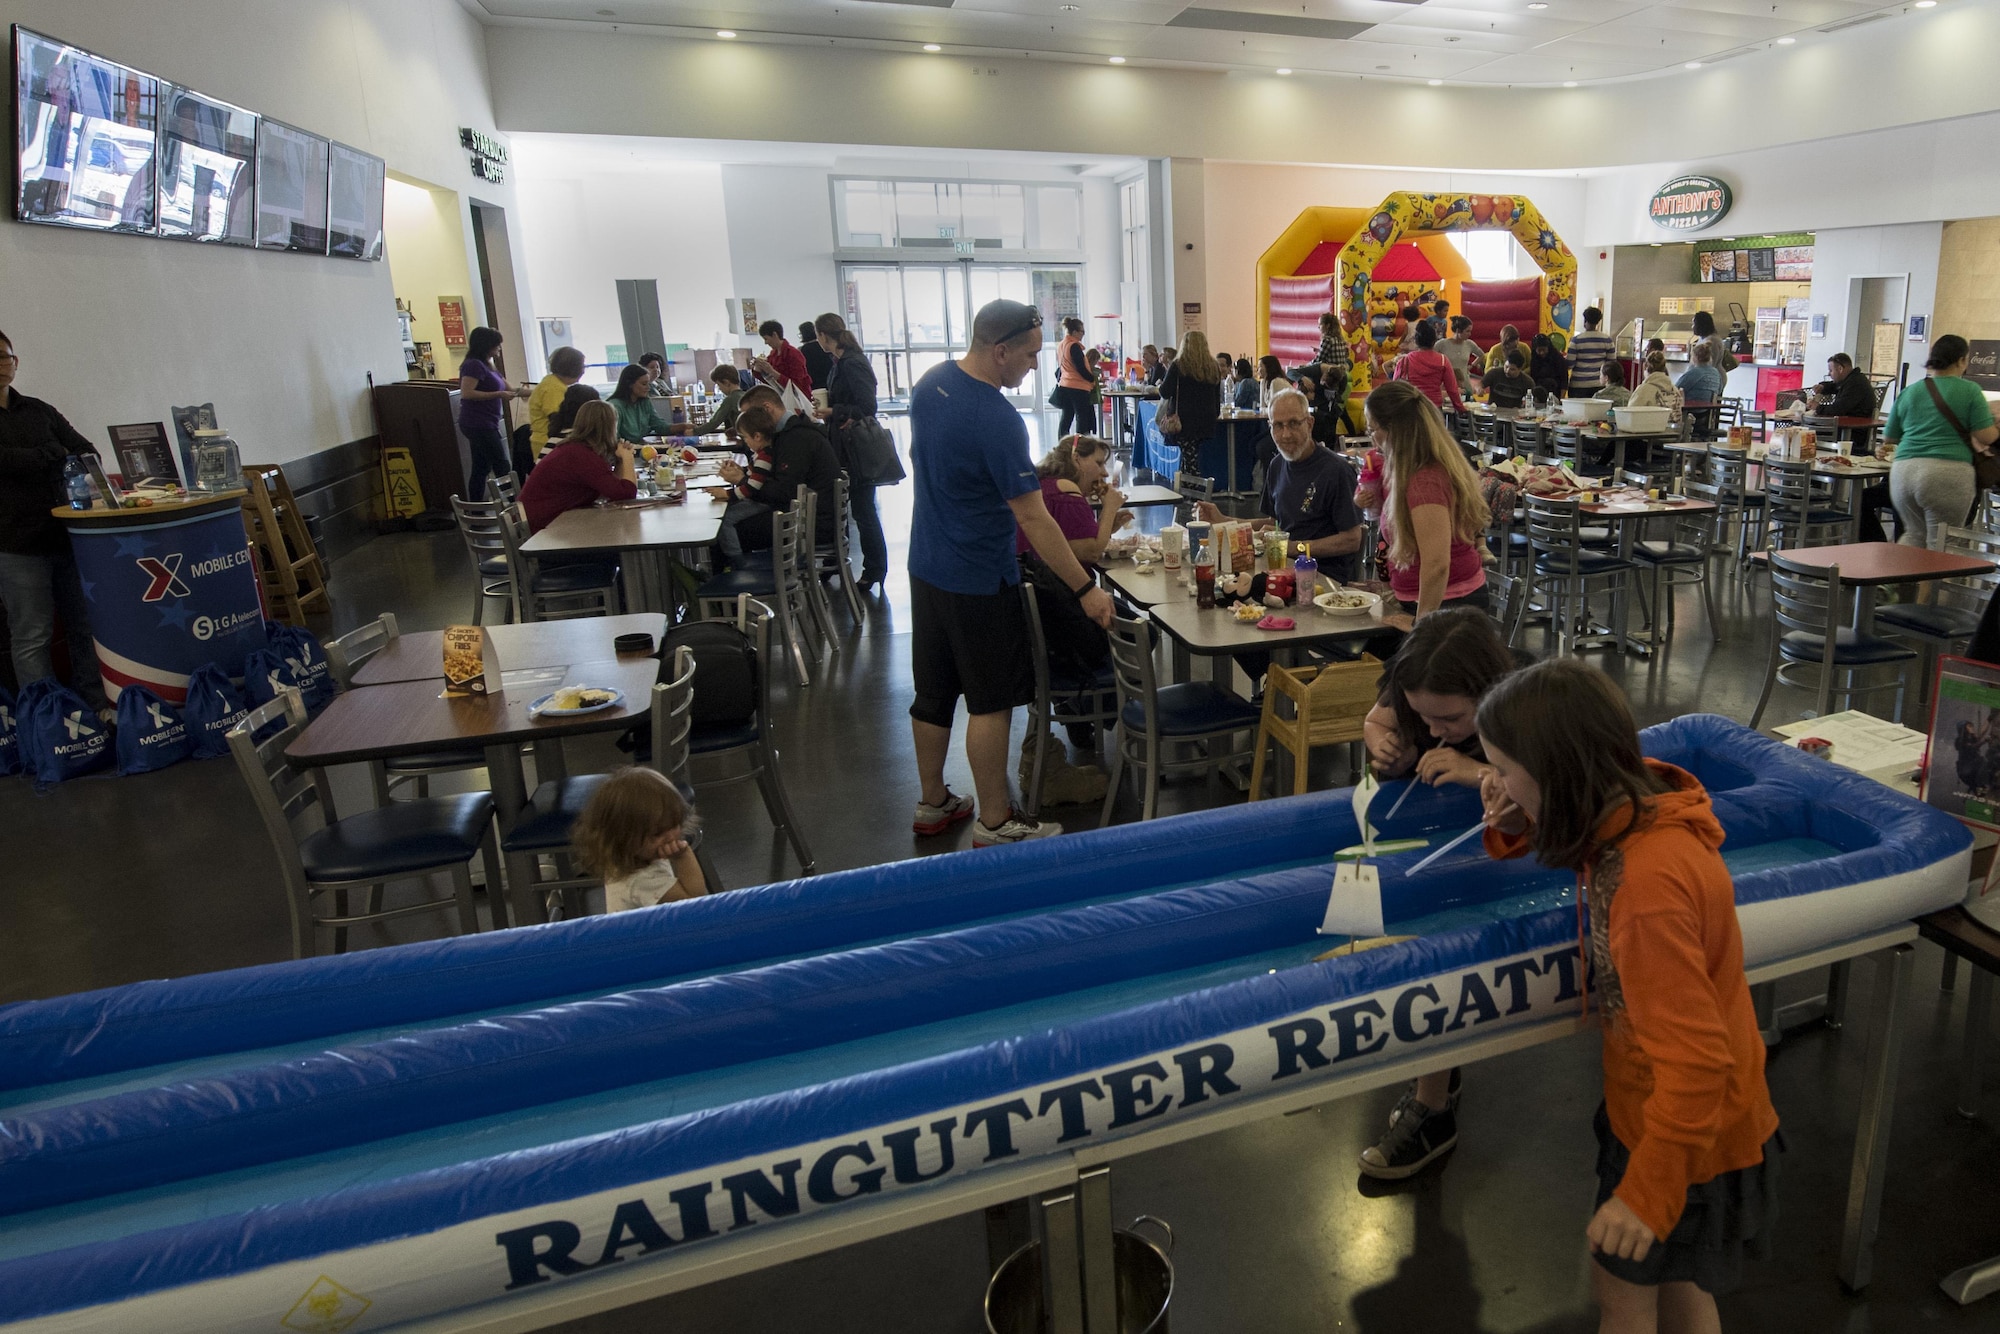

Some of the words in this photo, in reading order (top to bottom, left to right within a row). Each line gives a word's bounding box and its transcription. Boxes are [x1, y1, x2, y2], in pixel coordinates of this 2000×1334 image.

[1651, 189, 1722, 216] ANTHONY'S
[1669, 215, 1699, 229] PIZZA
[939, 227, 955, 238] EXIT
[955, 241, 972, 254] EXIT
[190, 553, 235, 578] MOBILE
[447, 633, 480, 642] CHIPOTLE
[454, 642, 471, 650] FRIES
[496, 1042, 1242, 1291] RAINGUTTER
[1267, 945, 1595, 1081] REGATT
